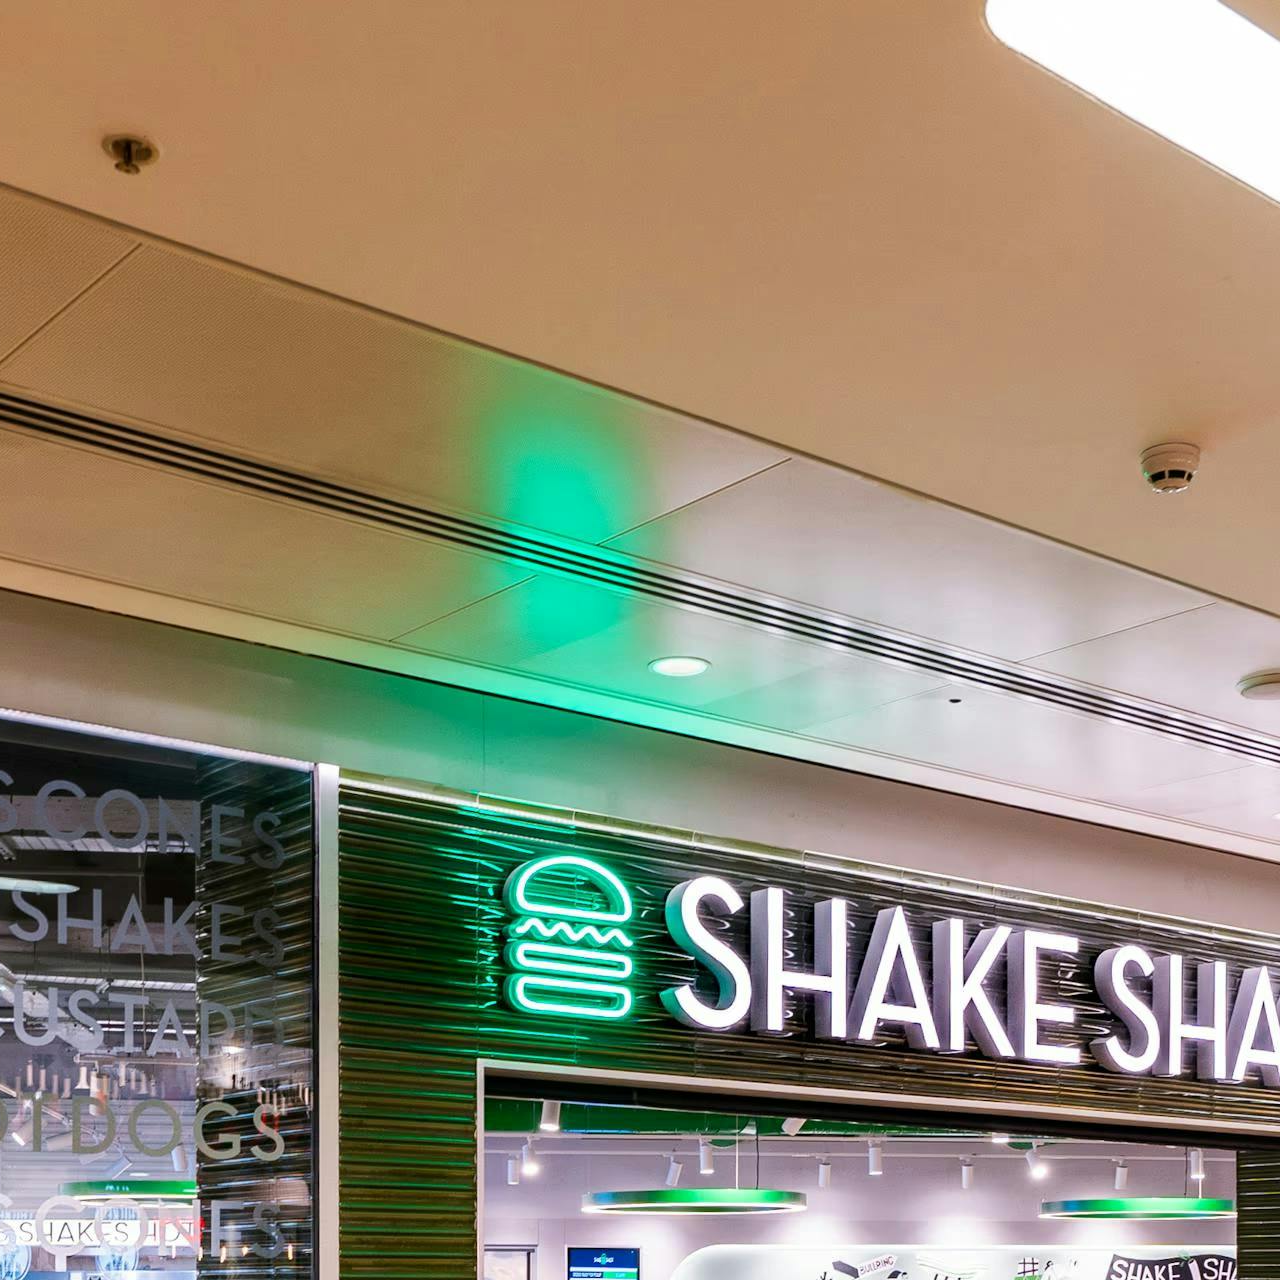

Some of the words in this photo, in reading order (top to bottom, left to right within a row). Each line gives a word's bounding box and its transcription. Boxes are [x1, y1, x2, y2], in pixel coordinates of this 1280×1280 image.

[33, 780, 286, 870] CONES
[9, 887, 284, 967] SHAKES
[662, 876, 1081, 1065] SHAKE
